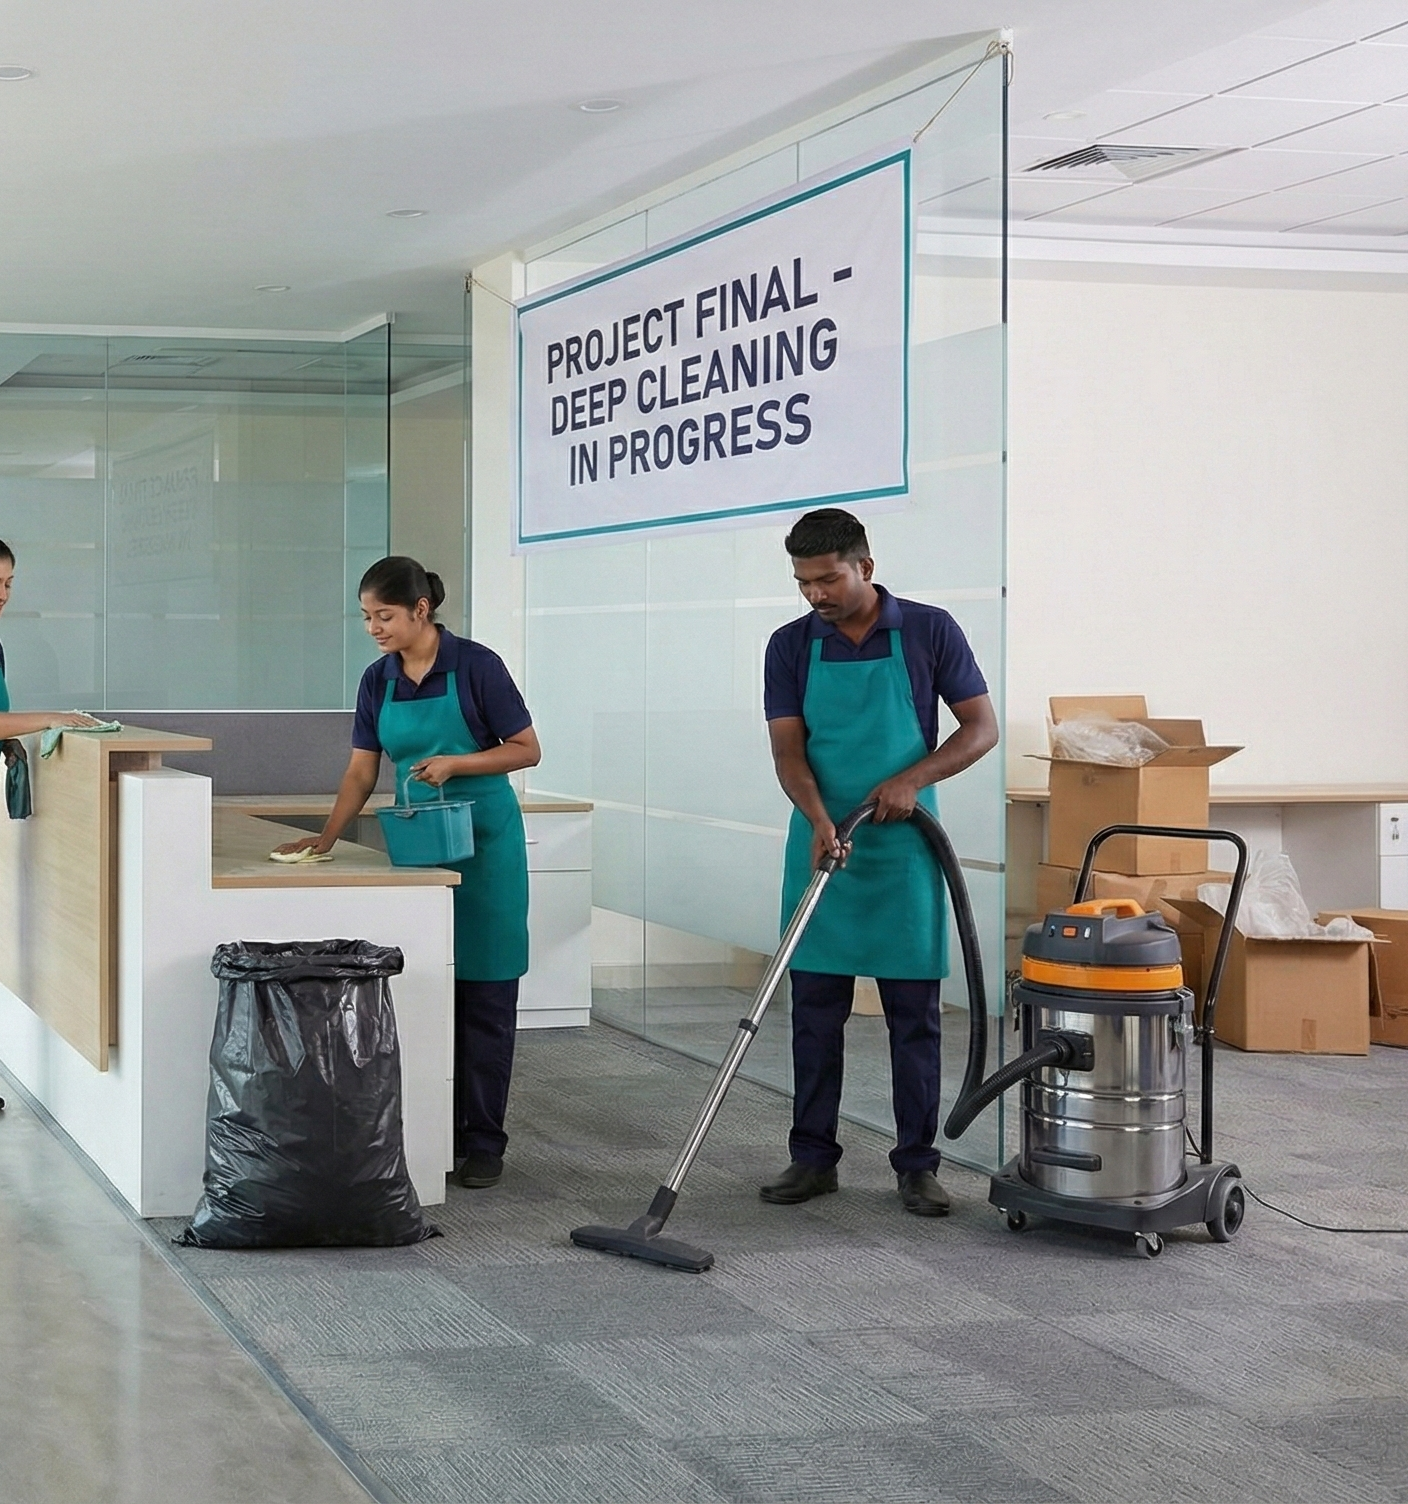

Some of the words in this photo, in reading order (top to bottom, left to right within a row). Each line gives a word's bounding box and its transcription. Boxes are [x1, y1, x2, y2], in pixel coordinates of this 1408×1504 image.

[546, 298, 685, 384] PROJECT
[696, 257, 818, 339] FINAL
[551, 377, 628, 436] DEEP
[637, 317, 838, 414] CLEANING
[570, 440, 598, 486] IN
[609, 392, 812, 479] PROGRESS
